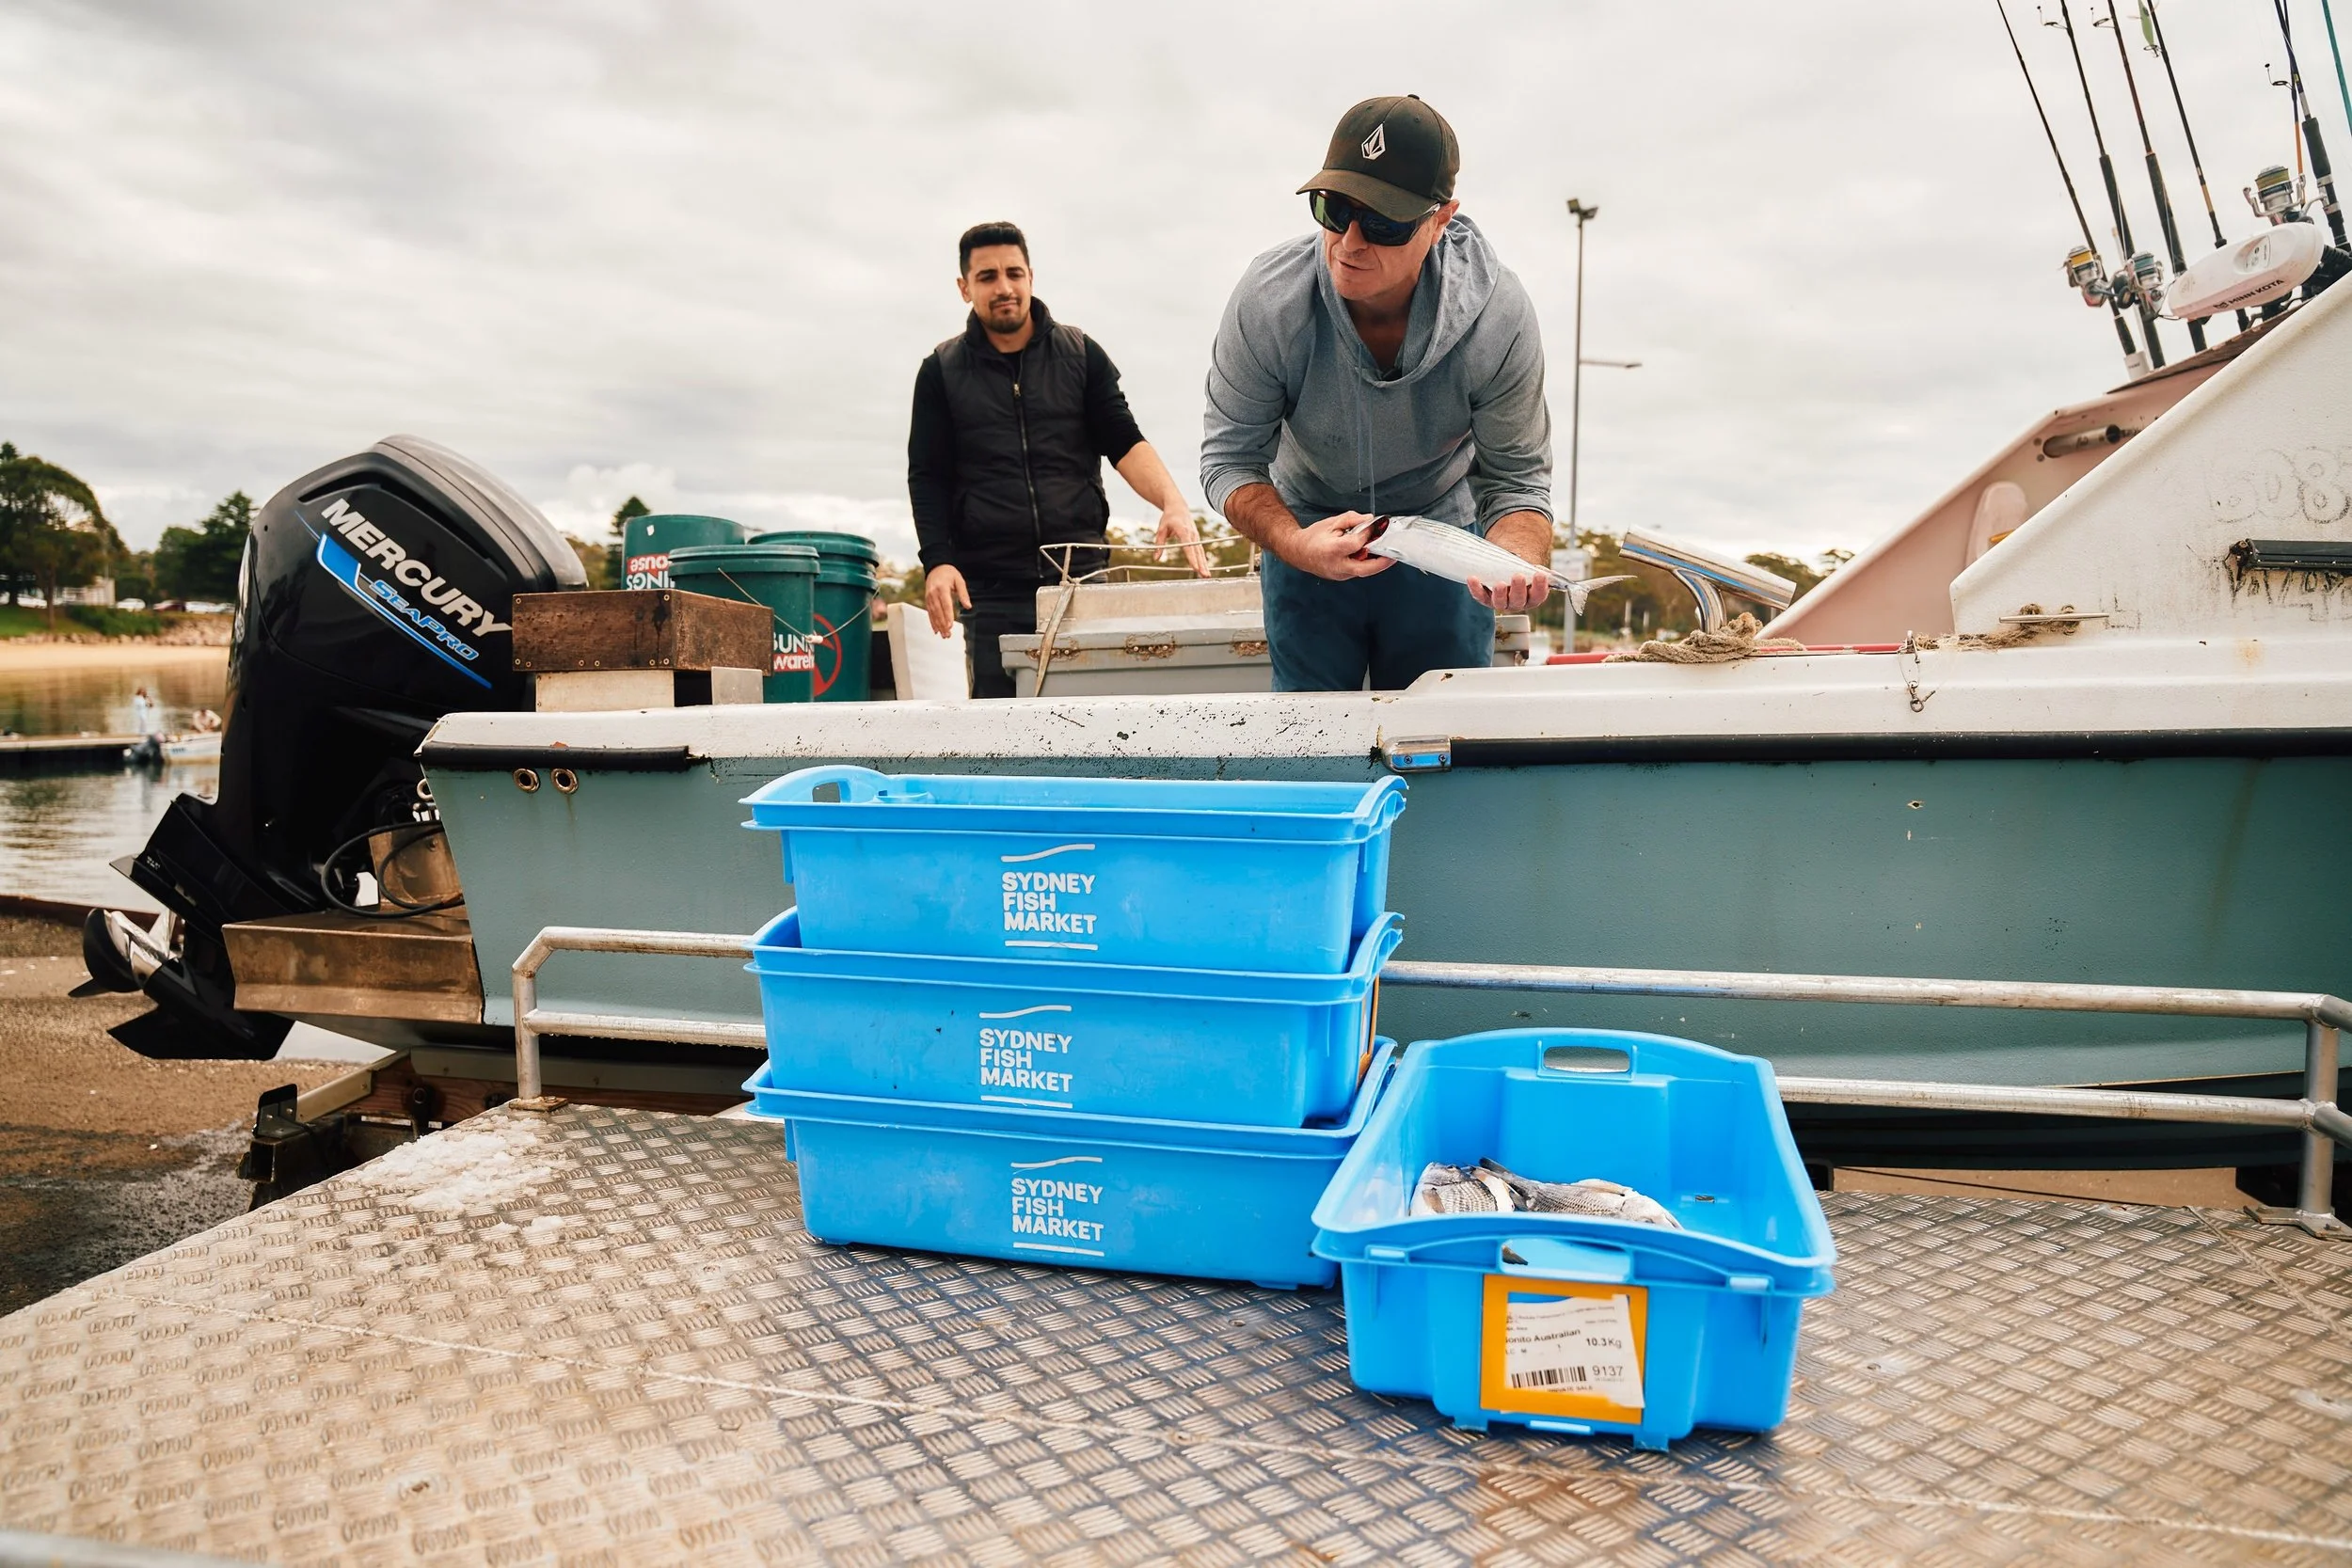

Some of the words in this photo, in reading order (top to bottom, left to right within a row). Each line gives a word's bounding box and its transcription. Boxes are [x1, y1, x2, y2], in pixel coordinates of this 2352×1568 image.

[2256, 279, 2285, 293] KOTA
[321, 498, 513, 637] MERCURY
[630, 555, 673, 572] ouse
[1002, 872, 1095, 894] SYDNEY
[1003, 892, 1057, 911] FISH
[1004, 911, 1097, 934] MARKET
[979, 1028, 1073, 1053] SYDNEY
[980, 1048, 1032, 1069] FISH
[980, 1067, 1073, 1092] MARKET
[1011, 1178, 1103, 1204] SYDNEY
[1012, 1196, 1063, 1216] FISH
[1012, 1214, 1104, 1242] MARKET
[1534, 1328, 1581, 1342] Australian
[1592, 1365, 1624, 1377] 9137
